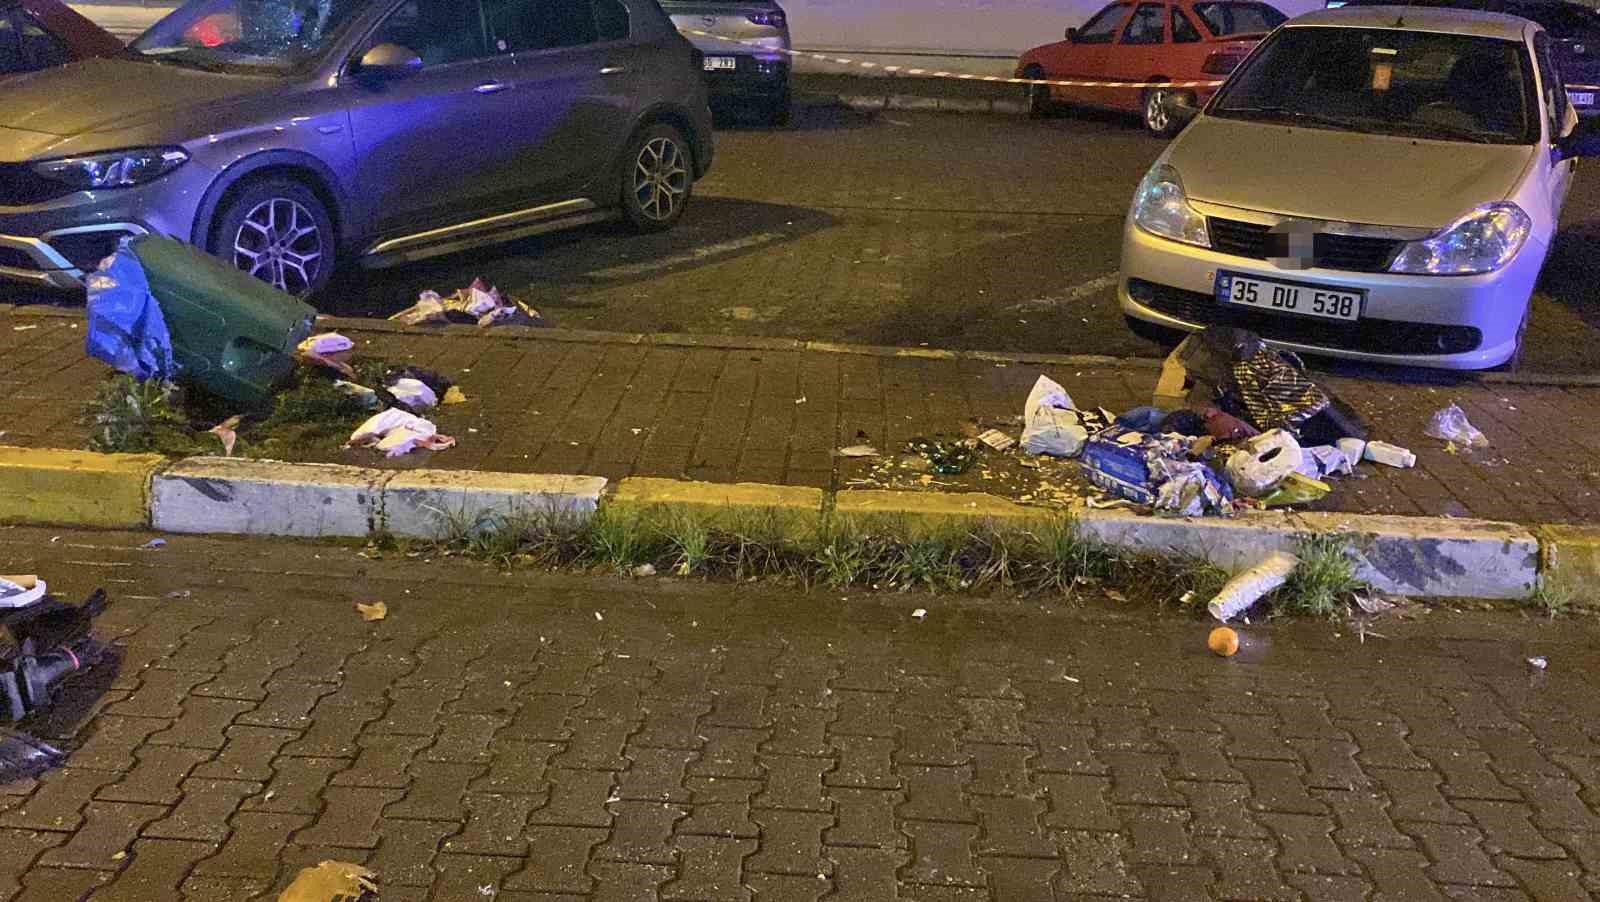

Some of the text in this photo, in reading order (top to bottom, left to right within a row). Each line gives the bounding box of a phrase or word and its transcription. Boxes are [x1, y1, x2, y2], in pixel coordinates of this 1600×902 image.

[1233, 281, 1353, 317] 35 DU 538
